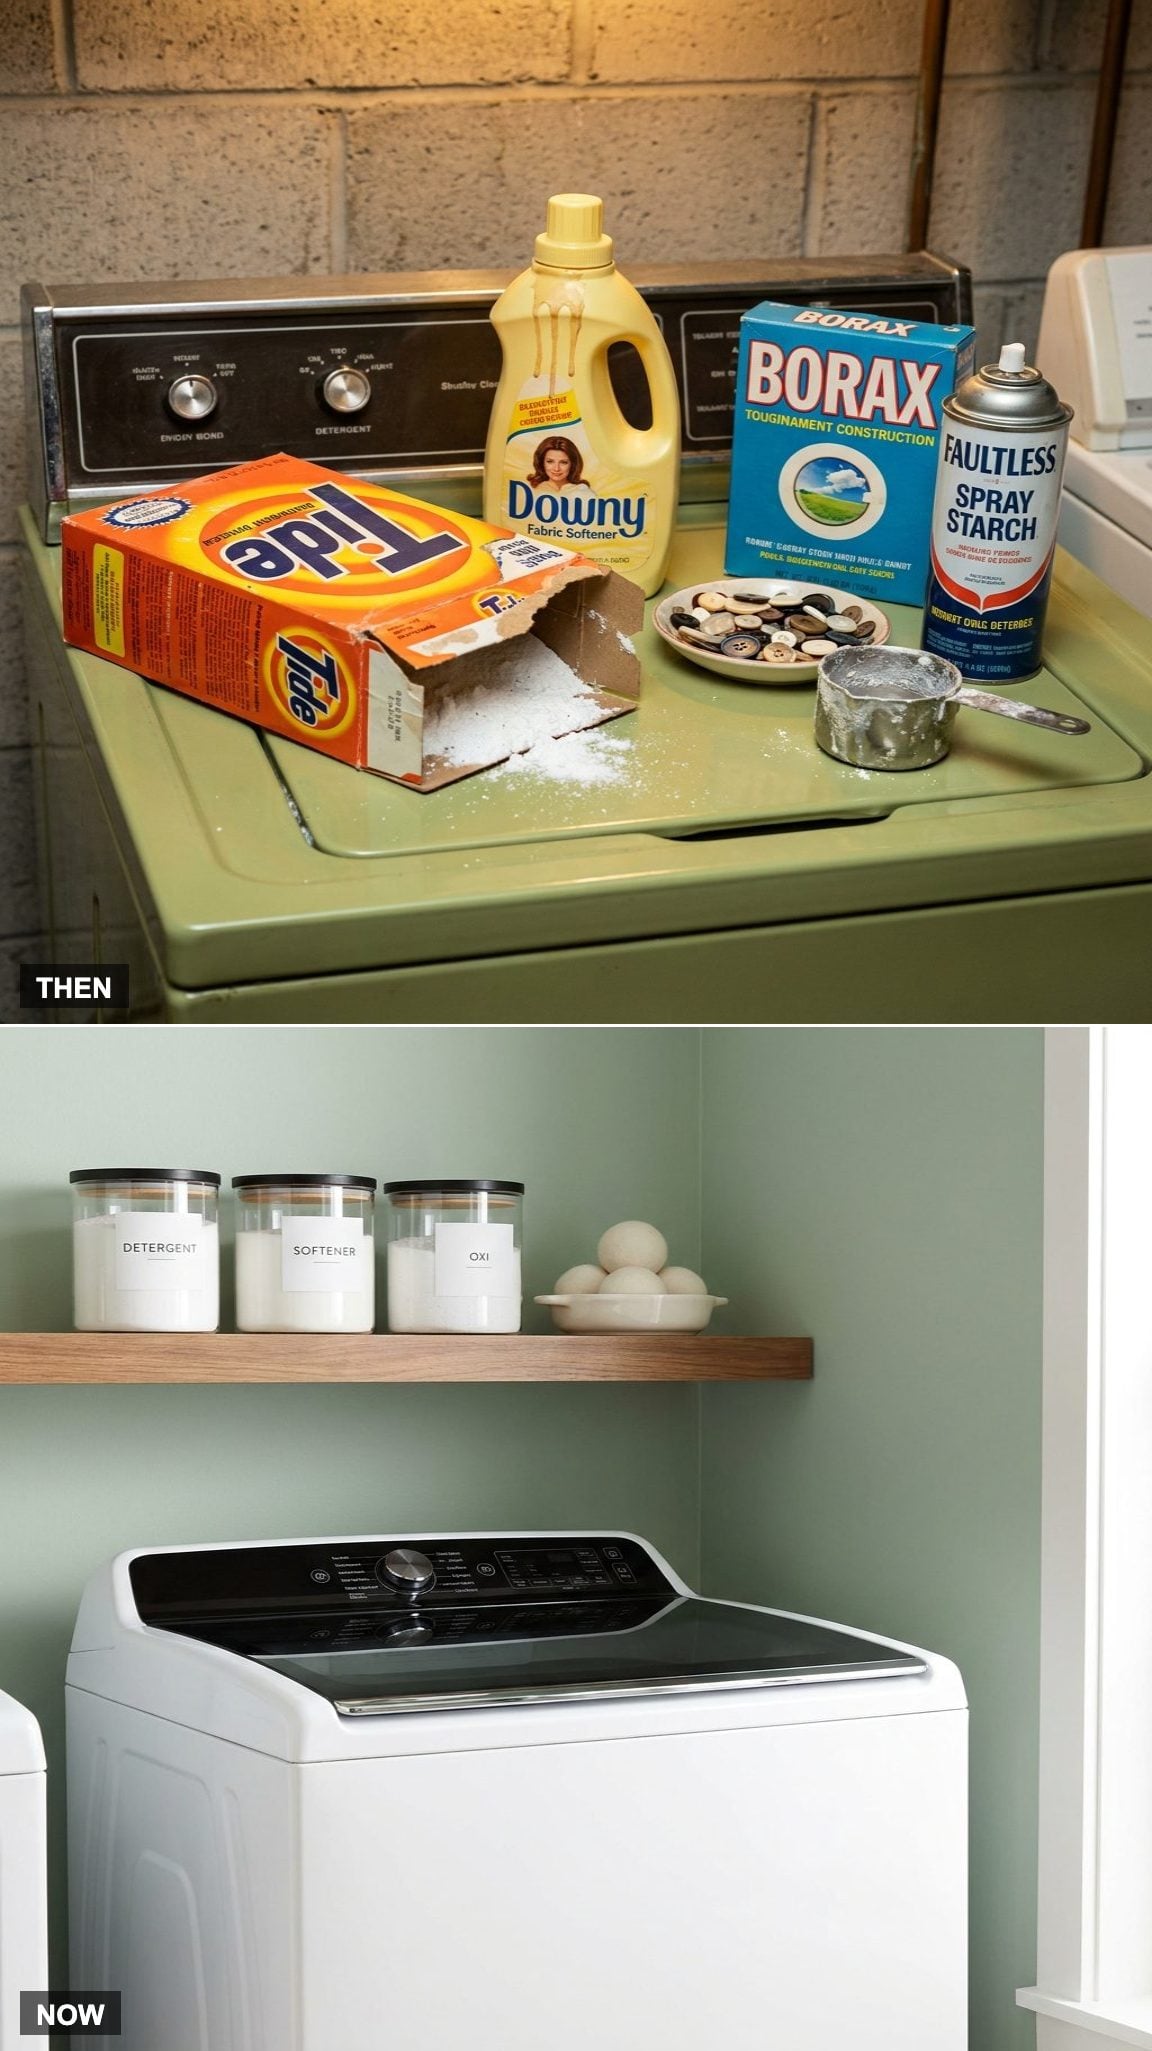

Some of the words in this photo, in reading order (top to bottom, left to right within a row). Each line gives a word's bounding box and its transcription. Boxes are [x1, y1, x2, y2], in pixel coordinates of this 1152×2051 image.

[793, 310, 917, 337] BORAX
[746, 339, 943, 430] BORAX
[745, 409, 834, 433] TOUGINAMENT
[836, 424, 935, 447] CONSTRUCTION
[944, 433, 1057, 477] FAULTLESS
[508, 479, 647, 538] Downy
[955, 483, 1035, 514] SPRAY
[221, 482, 468, 580] Tide
[527, 523, 563, 537] Fabric
[565, 527, 618, 540] Softener
[946, 508, 1038, 542] STARCH
[276, 632, 341, 727] Tide
[122, 1241, 198, 1254] DETERGENT
[293, 1246, 356, 1257] SOFTENER
[469, 1252, 489, 1262] OXI
